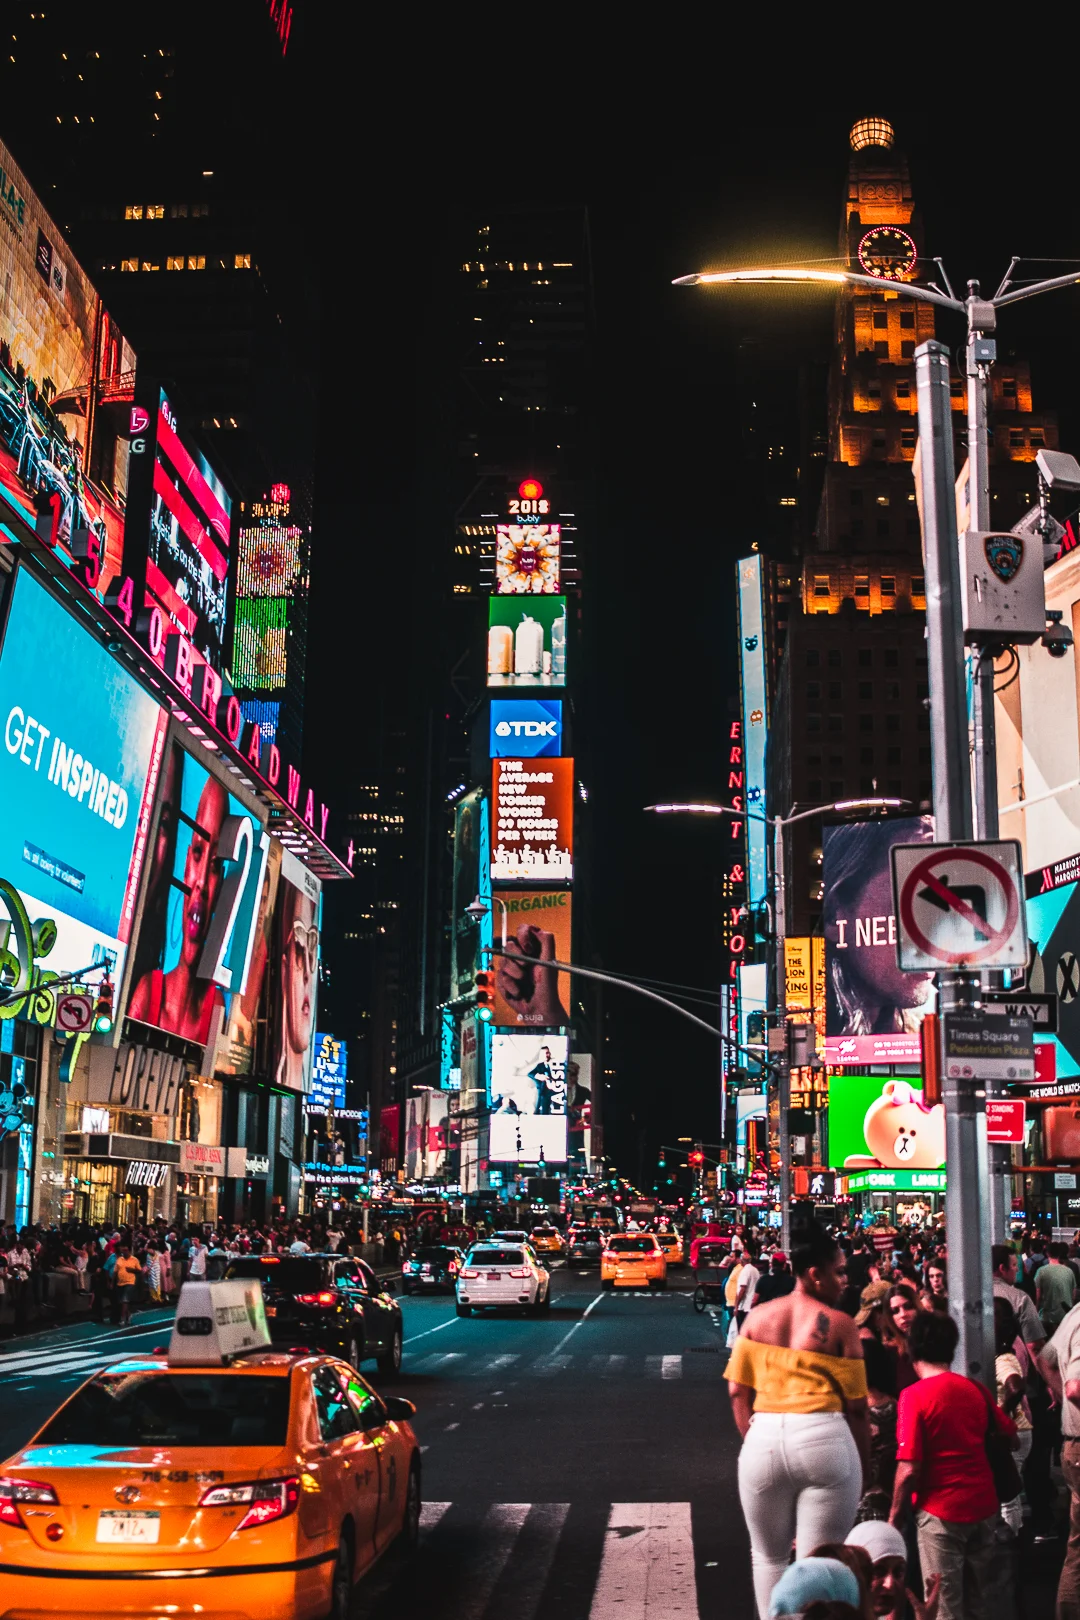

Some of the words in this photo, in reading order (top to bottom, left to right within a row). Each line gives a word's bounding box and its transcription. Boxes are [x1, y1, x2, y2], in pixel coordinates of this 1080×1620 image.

[129, 438, 146, 454] G
[508, 499, 550, 514] 2018
[509, 721, 558, 737] TDK
[174, 633, 331, 842] BROADWAY
[4, 705, 51, 772] GET
[47, 736, 129, 831] INSPIRED
[144, 729, 165, 801] SERVICE
[499, 761, 523, 772] THE
[499, 772, 554, 783] AVERAGE
[728, 721, 744, 839] ERNST
[498, 783, 528, 795] NEW
[498, 795, 546, 806] YORKER
[139, 806, 151, 833] OF
[498, 807, 543, 818] WORKS
[498, 818, 515, 829] 49
[517, 818, 559, 829] HOURS
[498, 829, 521, 841] PER
[523, 829, 557, 841] WEEK
[124, 837, 145, 920] SUMMER
[729, 864, 745, 882] &
[1054, 868, 1080, 885] MARQUIS
[212, 816, 271, 995] 21
[496, 892, 567, 914] ORGANIC
[835, 919, 848, 949] I
[787, 958, 802, 966] THE
[524, 1013, 544, 1023] suja
[1004, 1003, 1041, 1021] WAY
[949, 1029, 980, 1041] Times
[982, 1029, 1020, 1042] Square
[949, 1043, 1002, 1055] Pedestrian
[1003, 1044, 1030, 1056] Plaza
[1029, 1089, 1040, 1098] THE
[1040, 1085, 1058, 1097] WORLD
[1058, 1084, 1064, 1095] IS
[990, 1104, 1014, 1113] STANDING
[125, 1160, 160, 1187] FOREVER
[157, 1163, 169, 1188] 21
